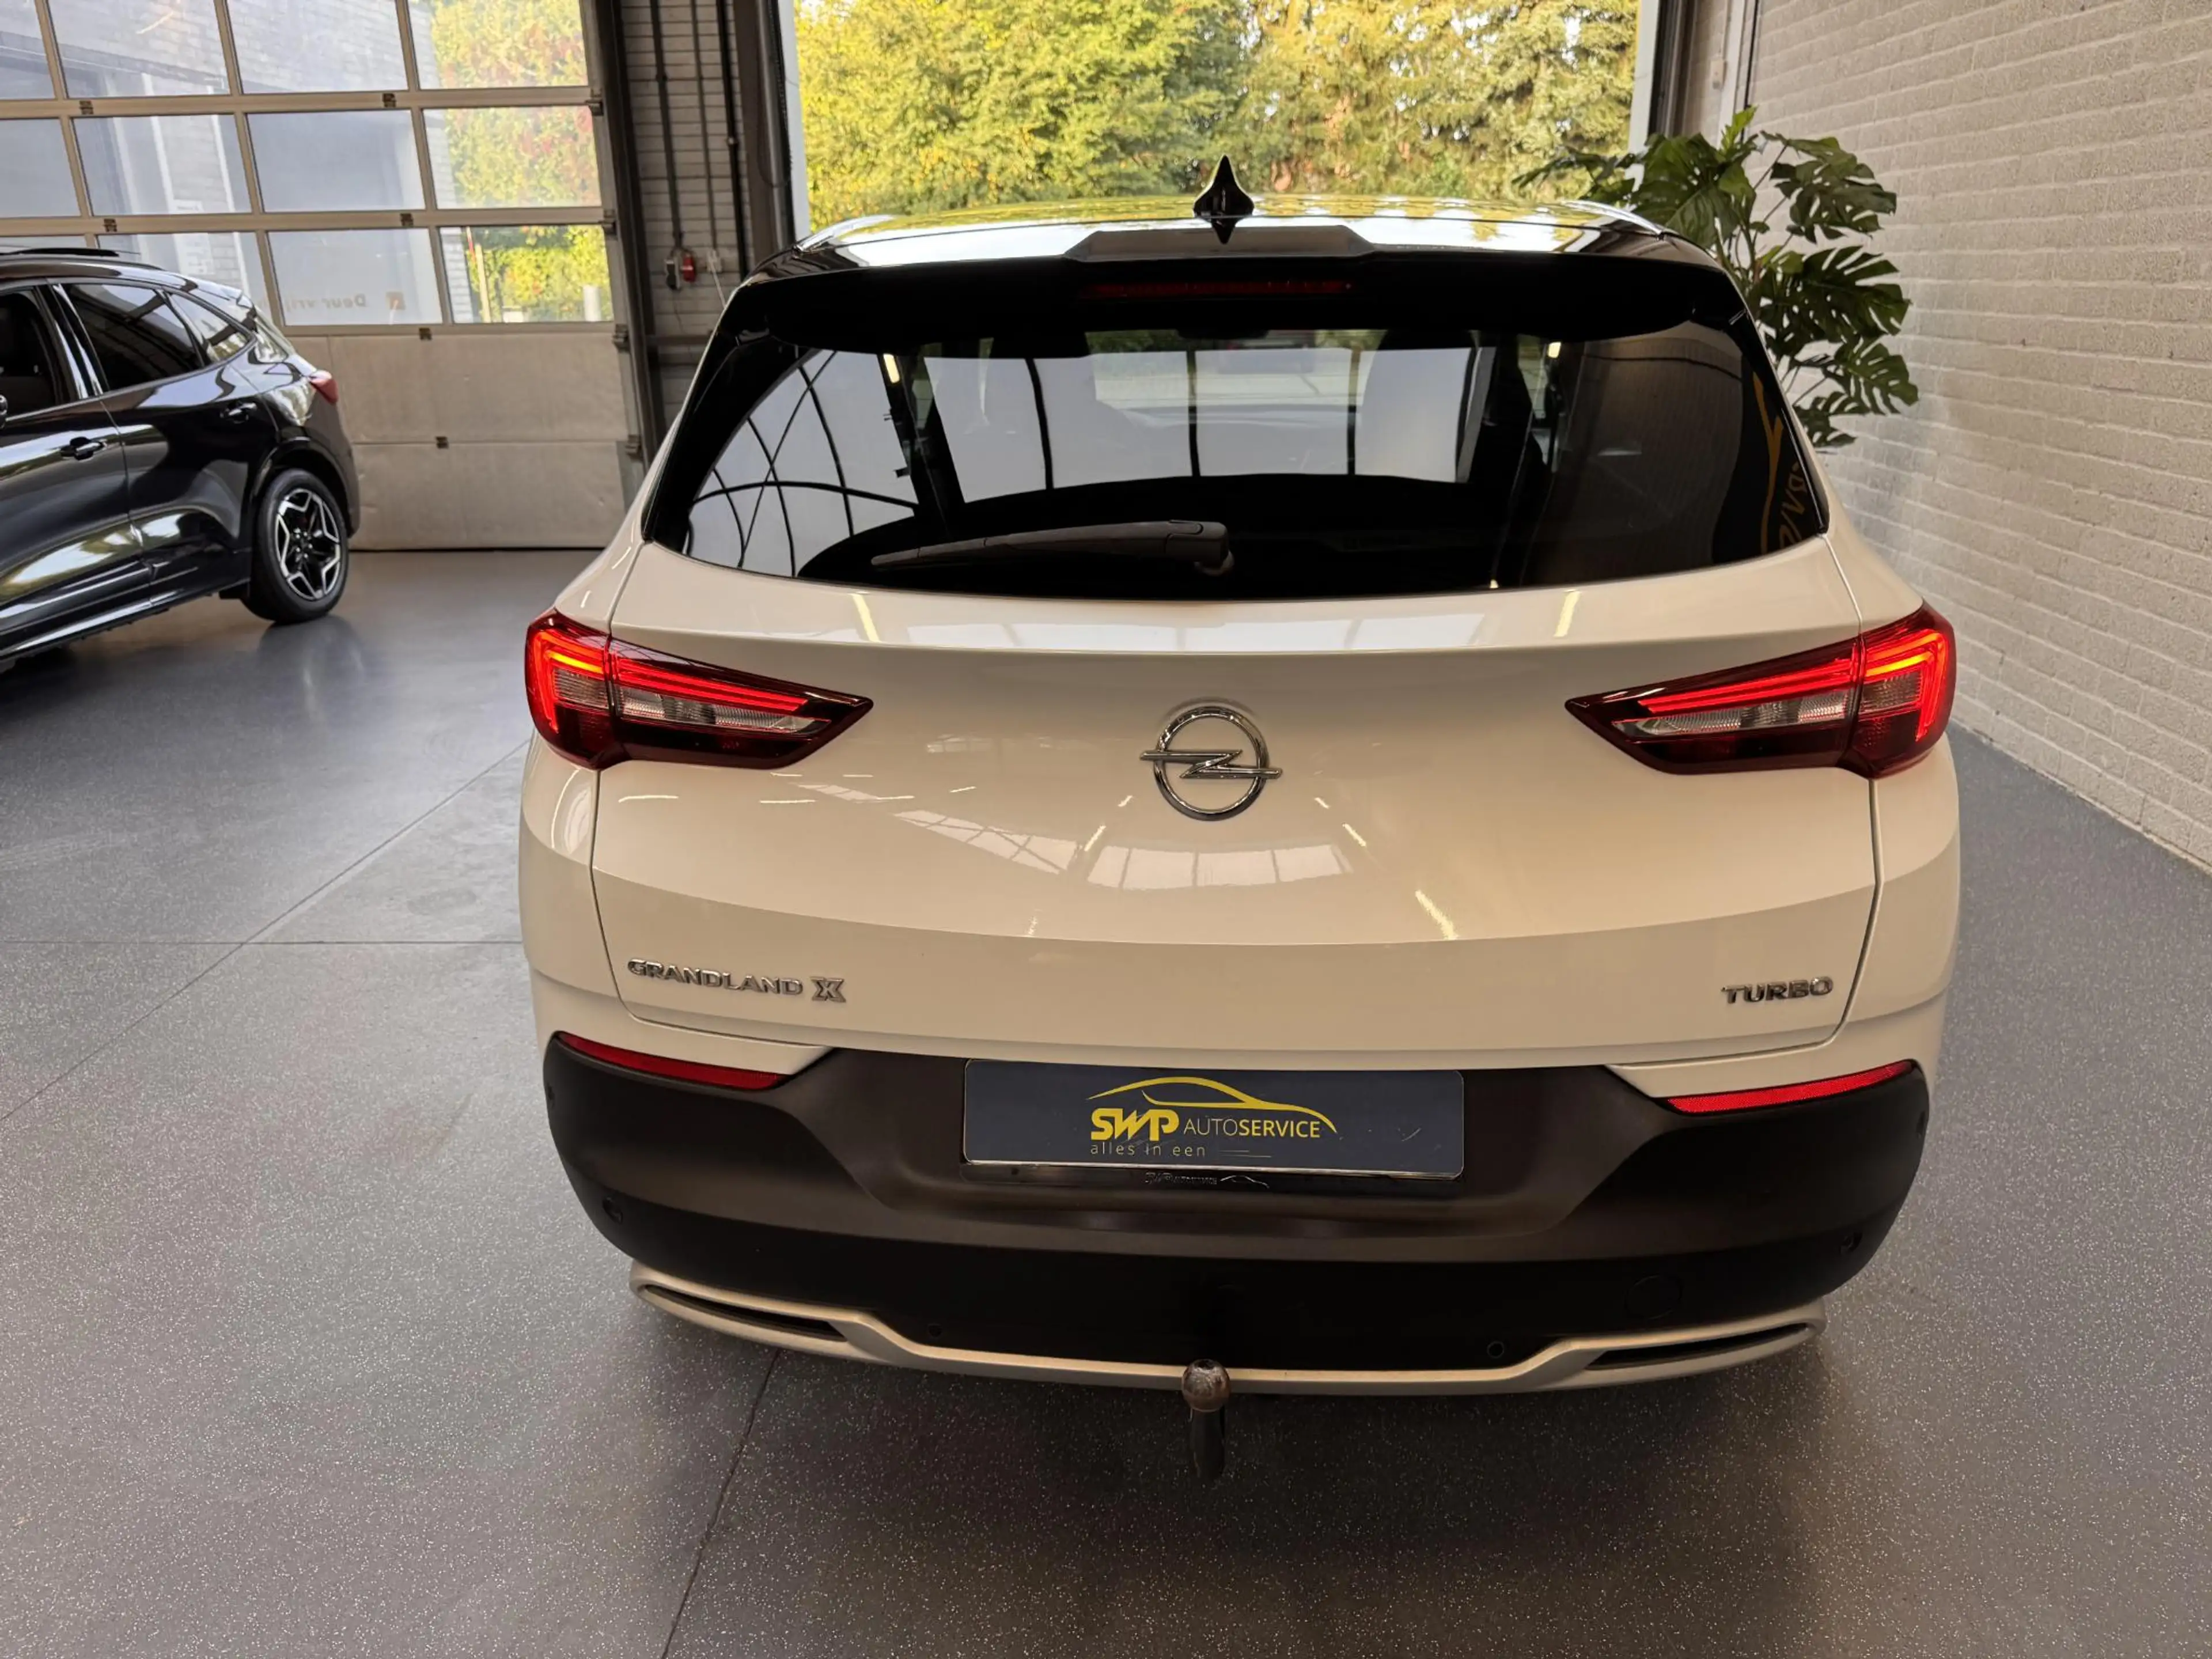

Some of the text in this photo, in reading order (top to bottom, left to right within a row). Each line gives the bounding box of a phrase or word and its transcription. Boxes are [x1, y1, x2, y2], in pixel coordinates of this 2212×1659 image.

[627, 959, 847, 1003] GRANDLAND X
[1721, 976, 1834, 1004] TURBO
[1091, 1108, 1321, 1141] SWP AUTOSERVICE
[1091, 1142, 1206, 1158] alles in een
